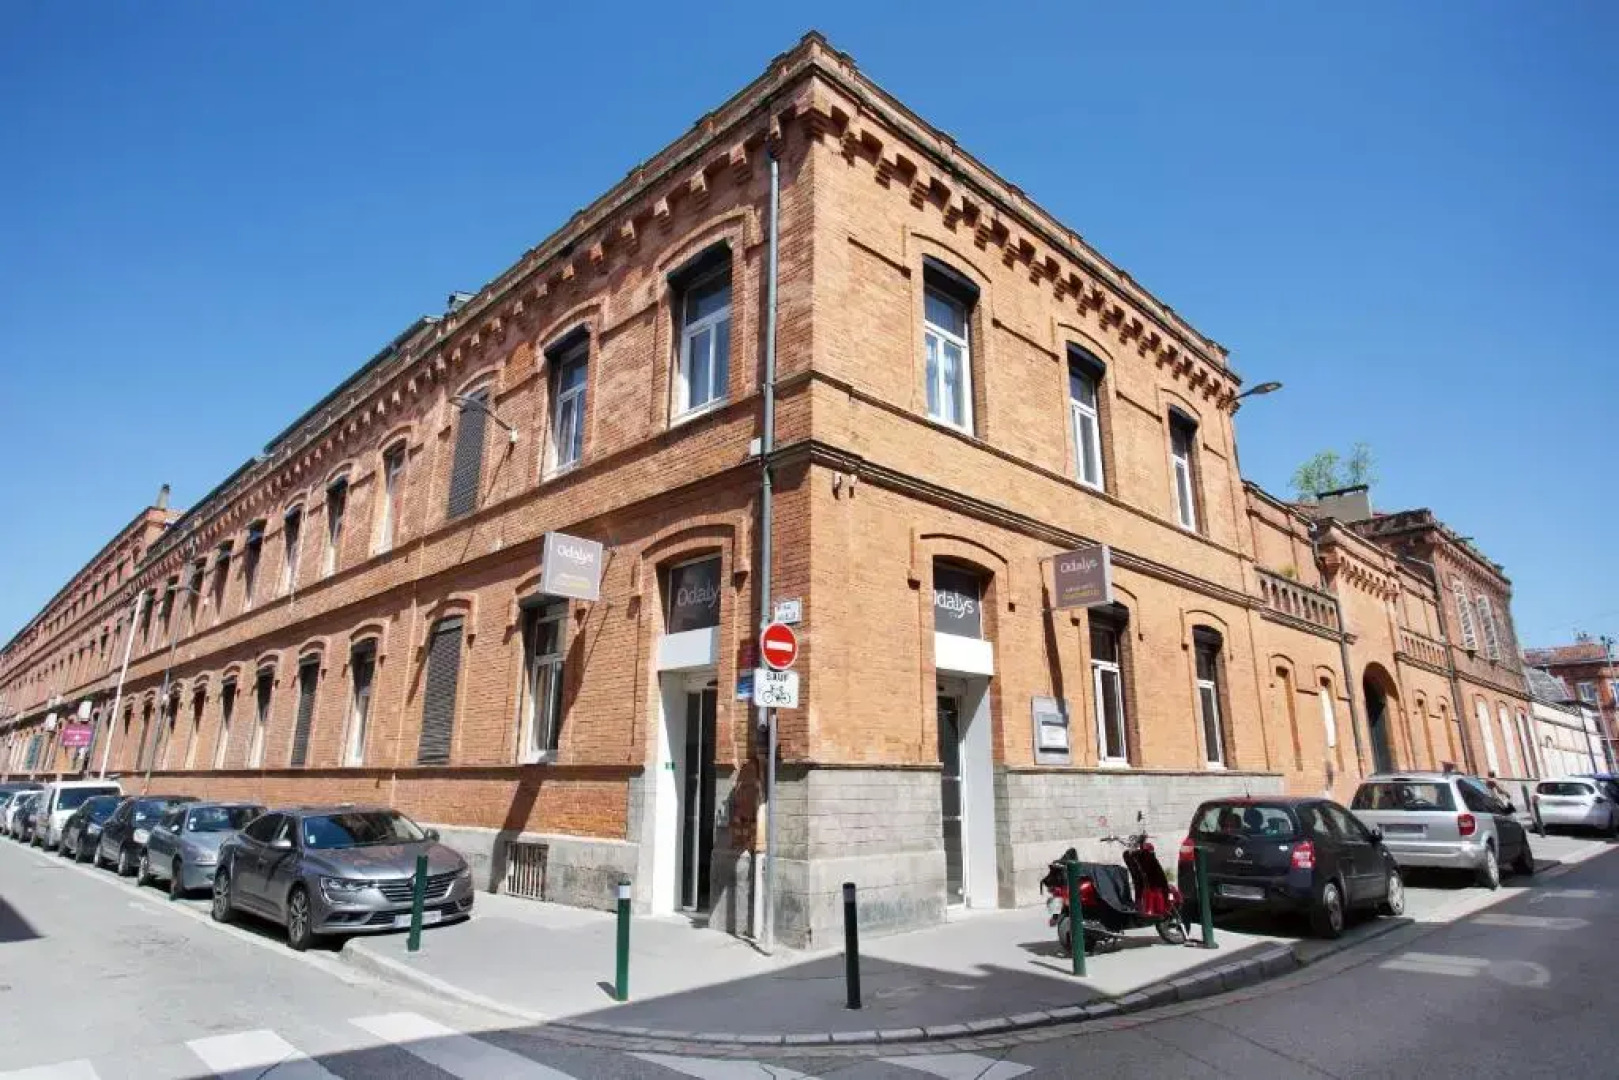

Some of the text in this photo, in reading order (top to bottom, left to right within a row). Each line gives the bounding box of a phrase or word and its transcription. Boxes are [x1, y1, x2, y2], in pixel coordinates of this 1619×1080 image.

[557, 545, 594, 566] Odalys
[1060, 556, 1099, 573] Odalys
[933, 588, 975, 619] dalys
[765, 672, 788, 682] SAUF
